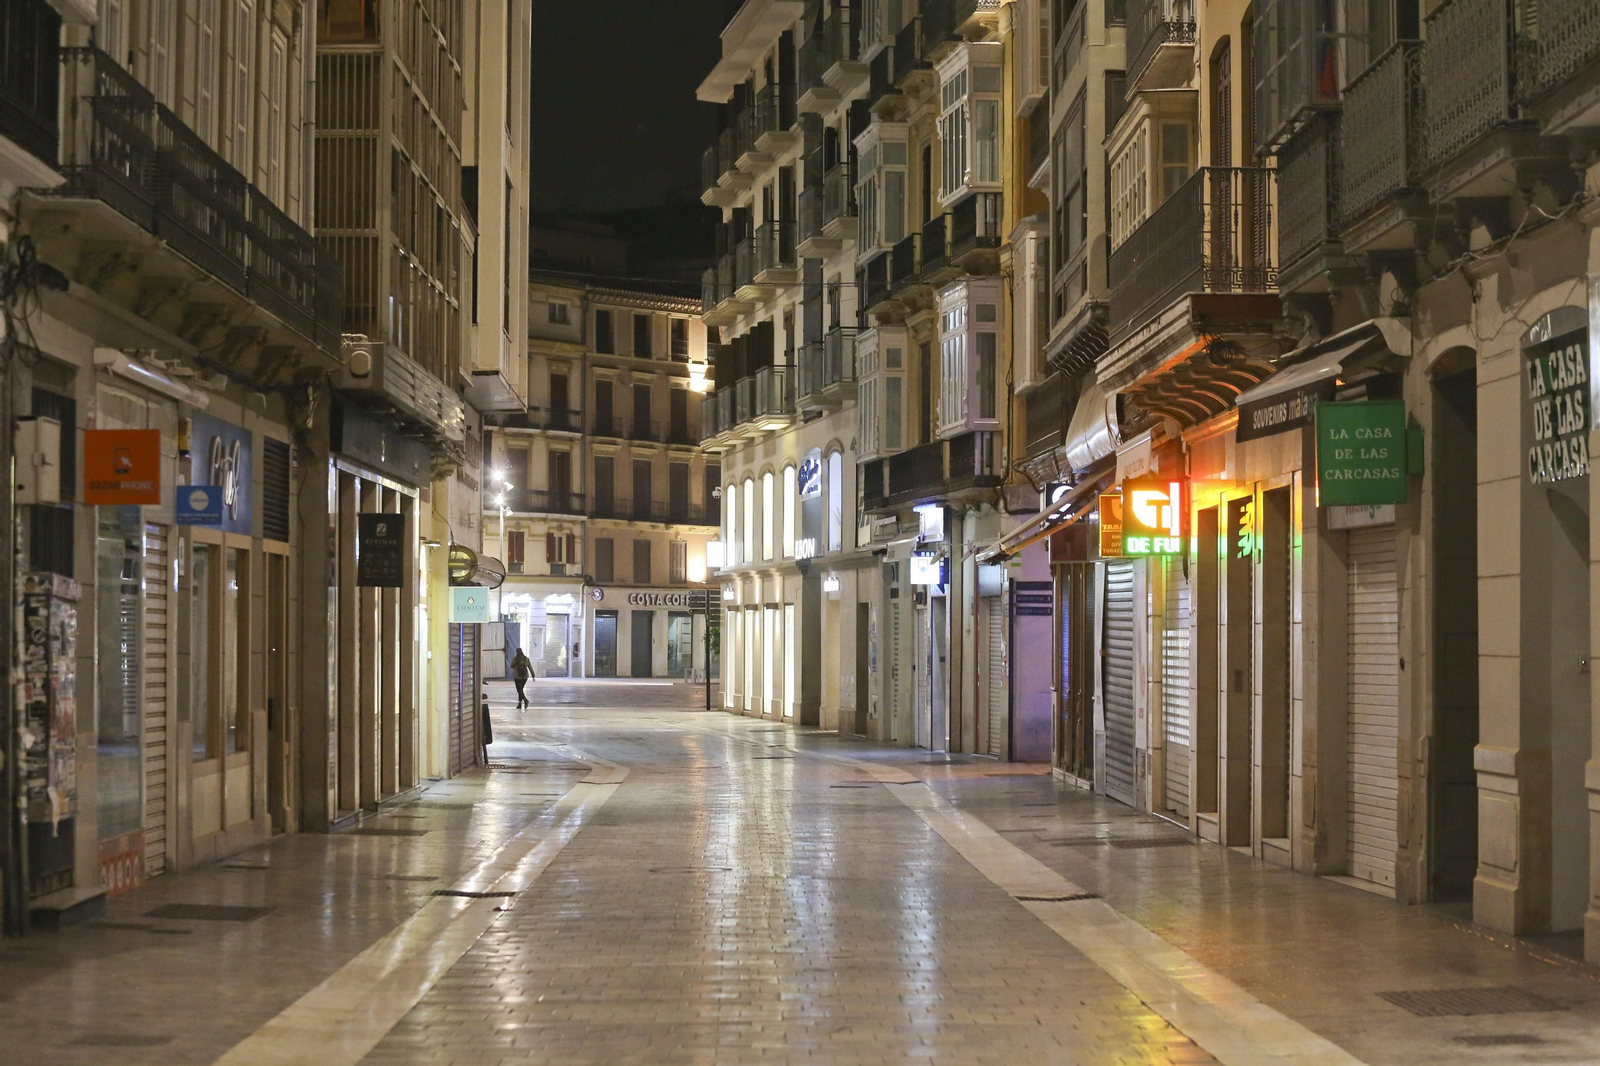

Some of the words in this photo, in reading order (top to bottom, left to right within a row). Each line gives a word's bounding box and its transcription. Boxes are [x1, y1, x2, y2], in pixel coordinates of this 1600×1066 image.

[1526, 358, 1546, 399] LA
[1549, 344, 1587, 391] CASA
[1253, 402, 1287, 430] SOUVENIRS
[1534, 399, 1552, 440] DE
[1555, 390, 1584, 435] LAS
[1330, 429, 1348, 440] LA
[1356, 428, 1392, 439] CASA
[1335, 449, 1353, 460] DE
[1361, 448, 1388, 459] LAS
[1529, 435, 1590, 485] CARCASA
[1325, 468, 1399, 480] CARCASAS
[1127, 537, 1150, 553] DE
[629, 593, 663, 606] COSTA
